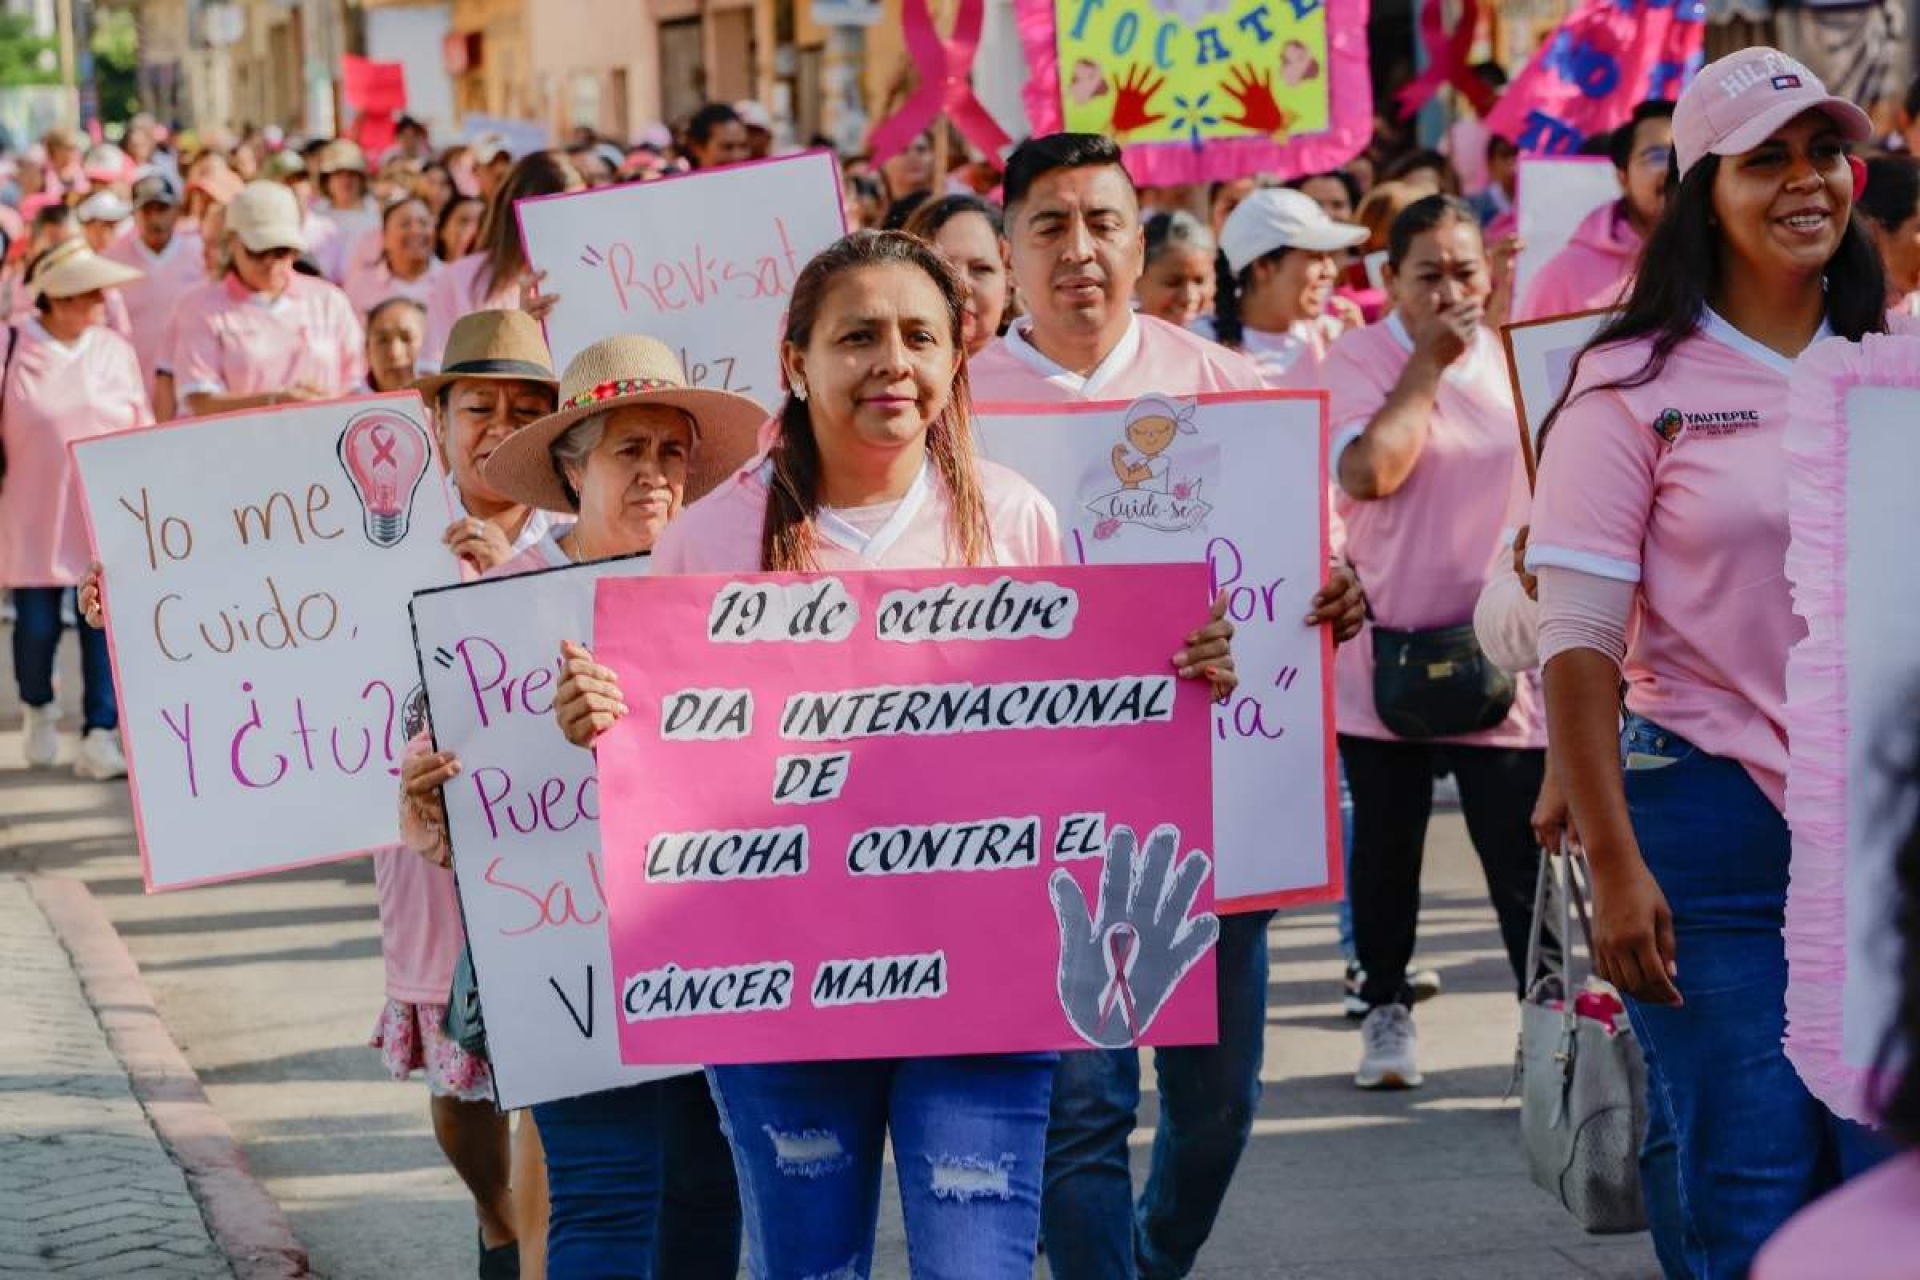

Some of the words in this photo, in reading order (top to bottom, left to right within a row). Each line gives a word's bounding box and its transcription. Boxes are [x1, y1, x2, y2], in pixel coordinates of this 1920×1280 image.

[1684, 410, 1759, 423] YAUTEPEC
[119, 487, 192, 570] Yo
[233, 484, 344, 544] me
[711, 591, 767, 637] 19
[788, 583, 847, 637] de
[879, 580, 1068, 634] octubre
[1206, 537, 1285, 622] Por
[154, 576, 358, 661] Cuido,
[665, 693, 748, 734] DIA
[783, 680, 1169, 735] INTERNACIONAL
[161, 703, 198, 797] Y
[775, 756, 845, 798] DE
[647, 833, 803, 877] LUCHA
[848, 821, 1036, 872] CONTRA
[1056, 818, 1102, 853] EL
[625, 967, 790, 1014] CÁNCER
[814, 957, 941, 999] MAMA
